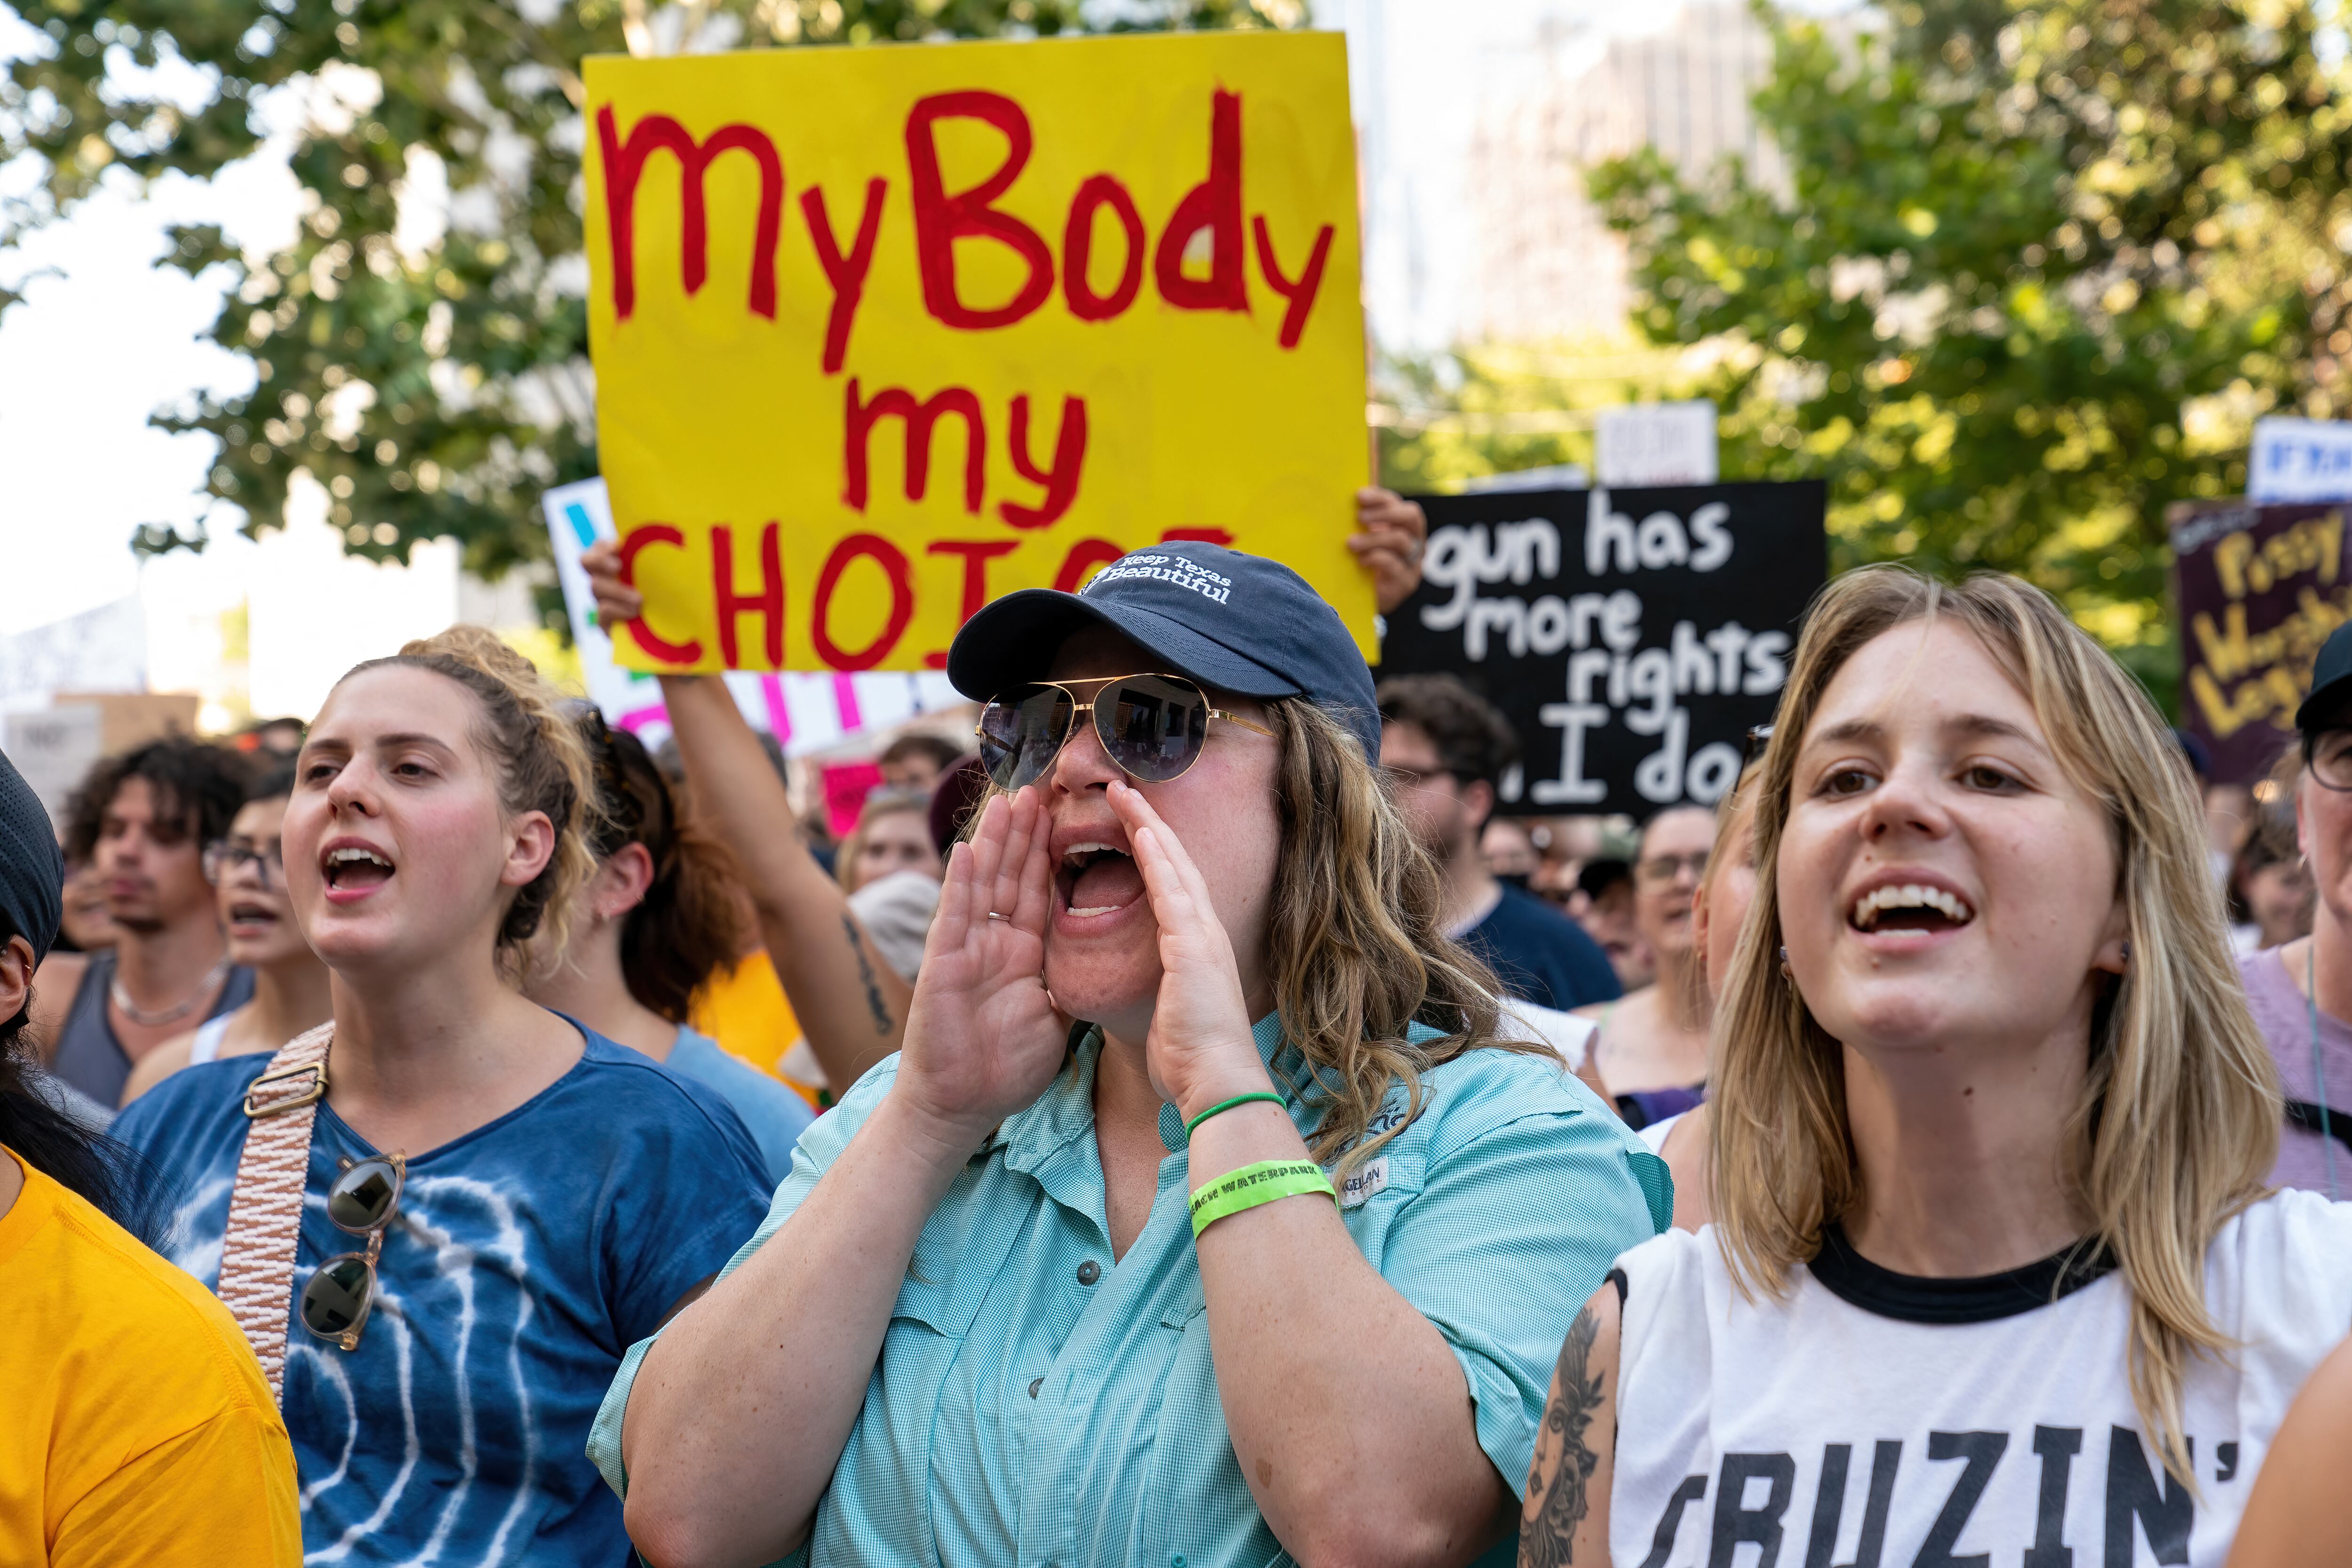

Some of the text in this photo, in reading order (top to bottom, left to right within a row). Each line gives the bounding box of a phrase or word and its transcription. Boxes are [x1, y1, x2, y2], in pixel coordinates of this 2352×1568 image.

[906, 82, 1334, 349] Body
[843, 378, 1087, 529] my
[613, 523, 1233, 671] CHOI
[1102, 566, 1231, 605] Beautiful
[1118, 554, 1232, 587] Keep Texas
[1421, 489, 1735, 631] gun has
[1464, 589, 1643, 660] more
[1566, 620, 1793, 736] rights
[1530, 703, 1611, 805] I
[1634, 707, 1743, 804] do
[1190, 1165, 1317, 1219] EACH WATERPARK
